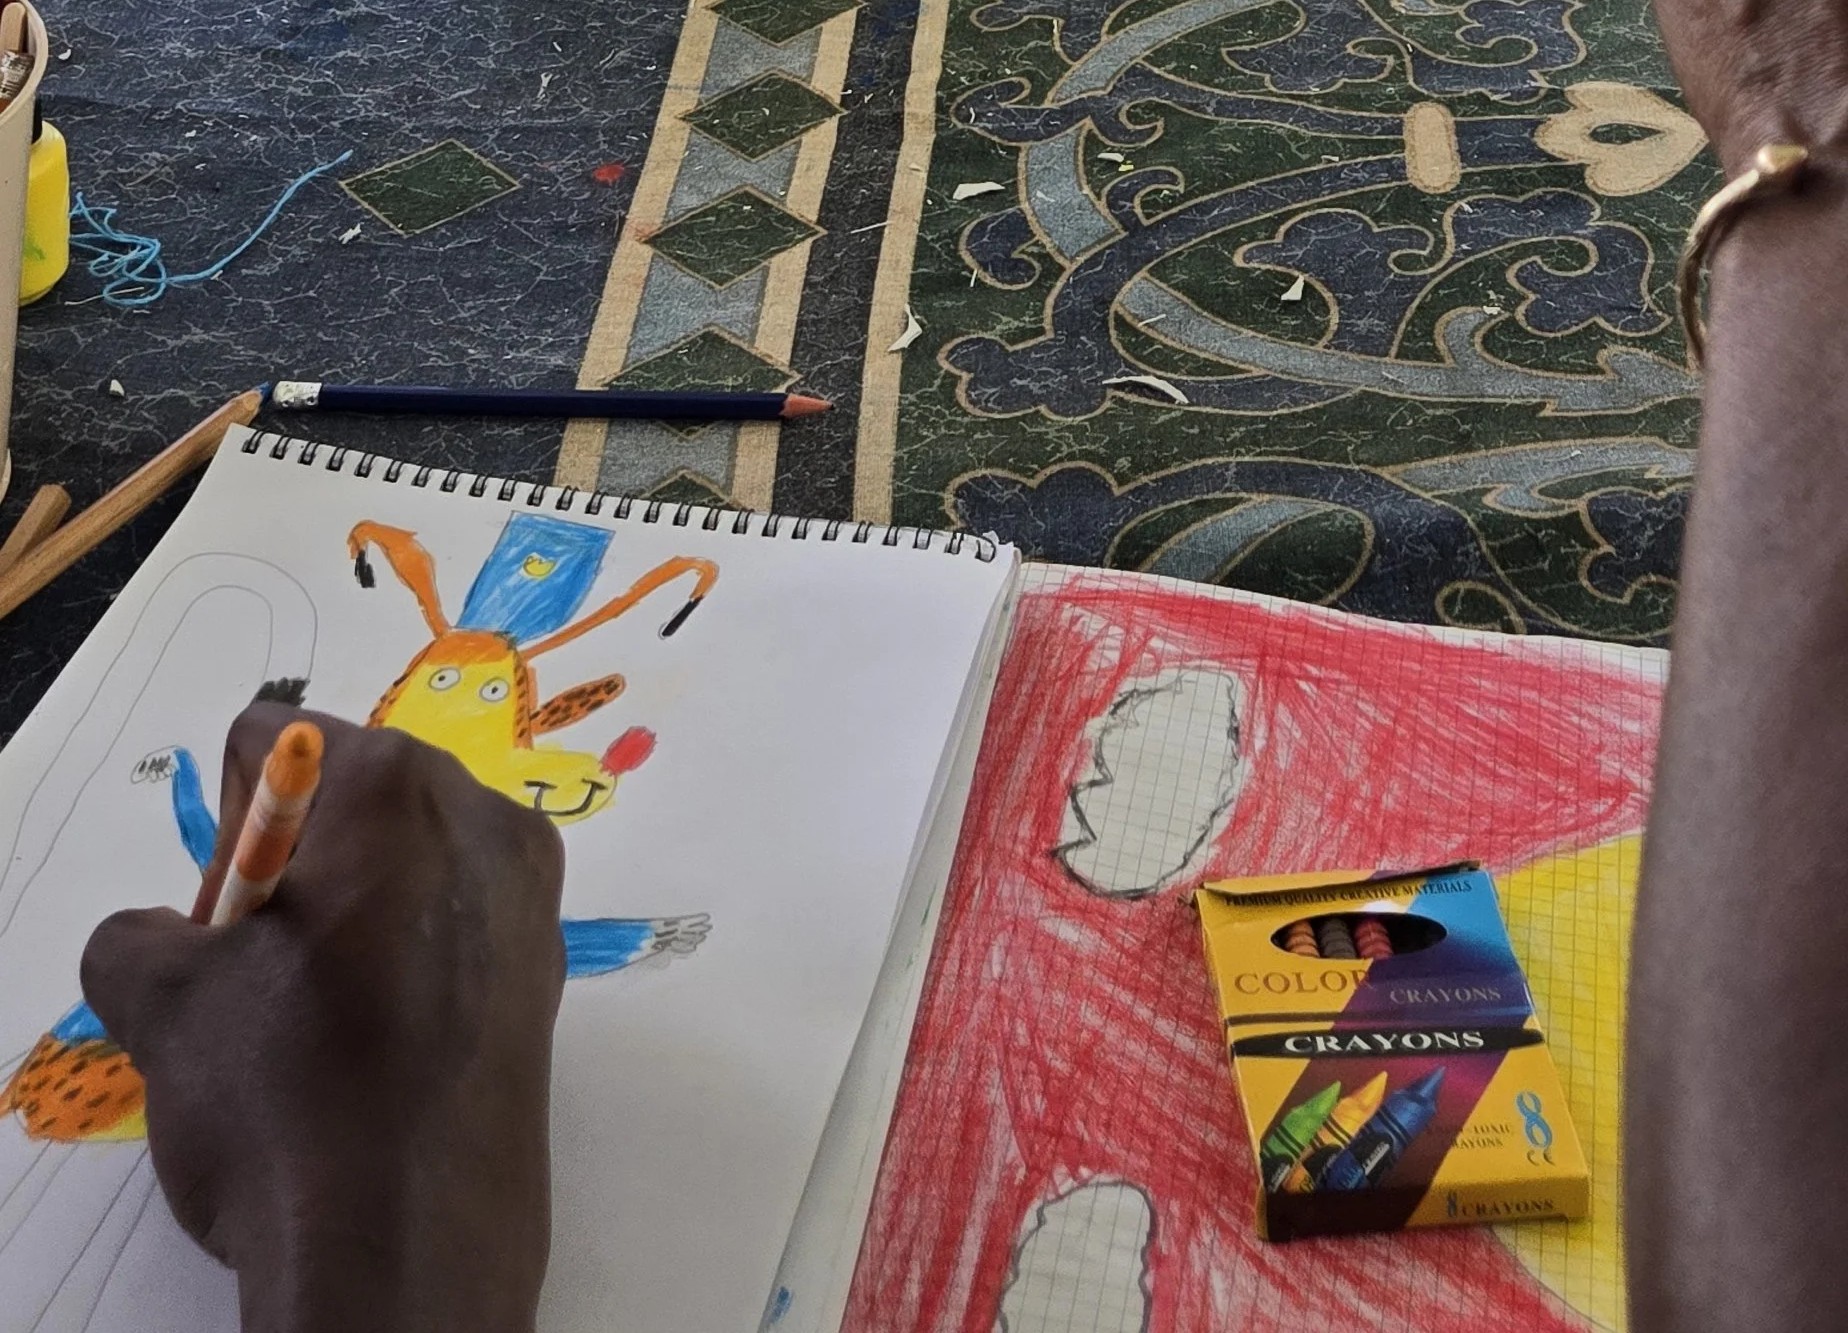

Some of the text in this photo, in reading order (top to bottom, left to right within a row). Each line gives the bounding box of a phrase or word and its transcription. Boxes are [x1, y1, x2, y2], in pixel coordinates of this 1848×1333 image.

[1225, 880, 1473, 907] PREMIUM QUALITY CREATIVE MATERIALS
[1234, 968, 1502, 1006] COLOR CRAYONS
[1284, 1031, 1485, 1054] CRAYONS
[1515, 1090, 1553, 1151] 8
[1460, 1198, 1556, 1218] CRAYONS
